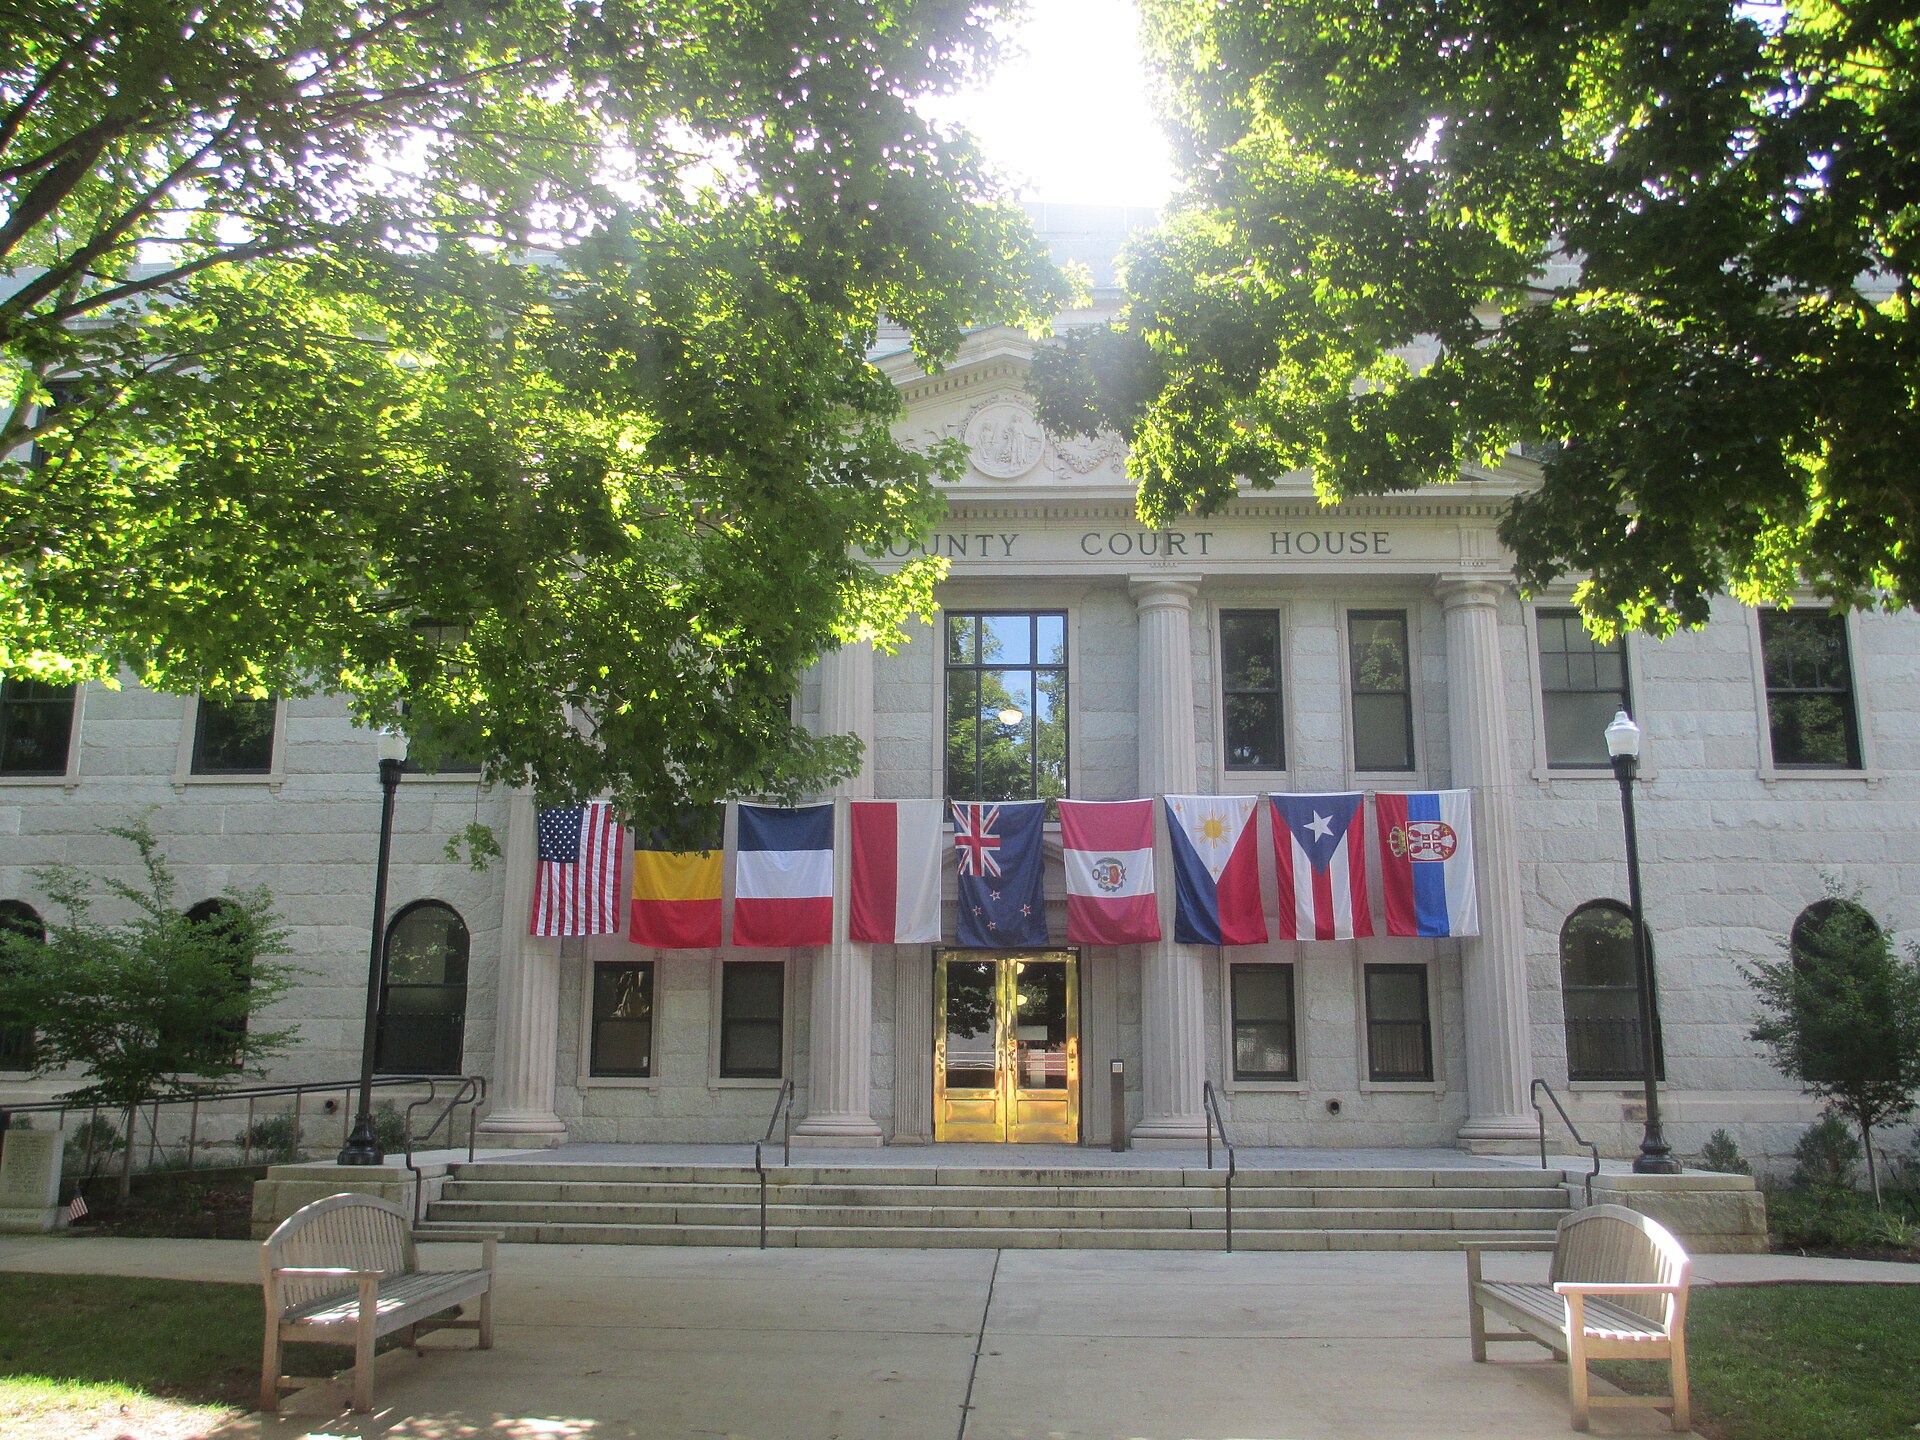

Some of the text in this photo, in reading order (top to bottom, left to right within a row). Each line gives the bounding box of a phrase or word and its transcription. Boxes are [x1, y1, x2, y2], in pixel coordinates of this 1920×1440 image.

[862, 531, 1392, 557] OUNTY COURT HOUSE
